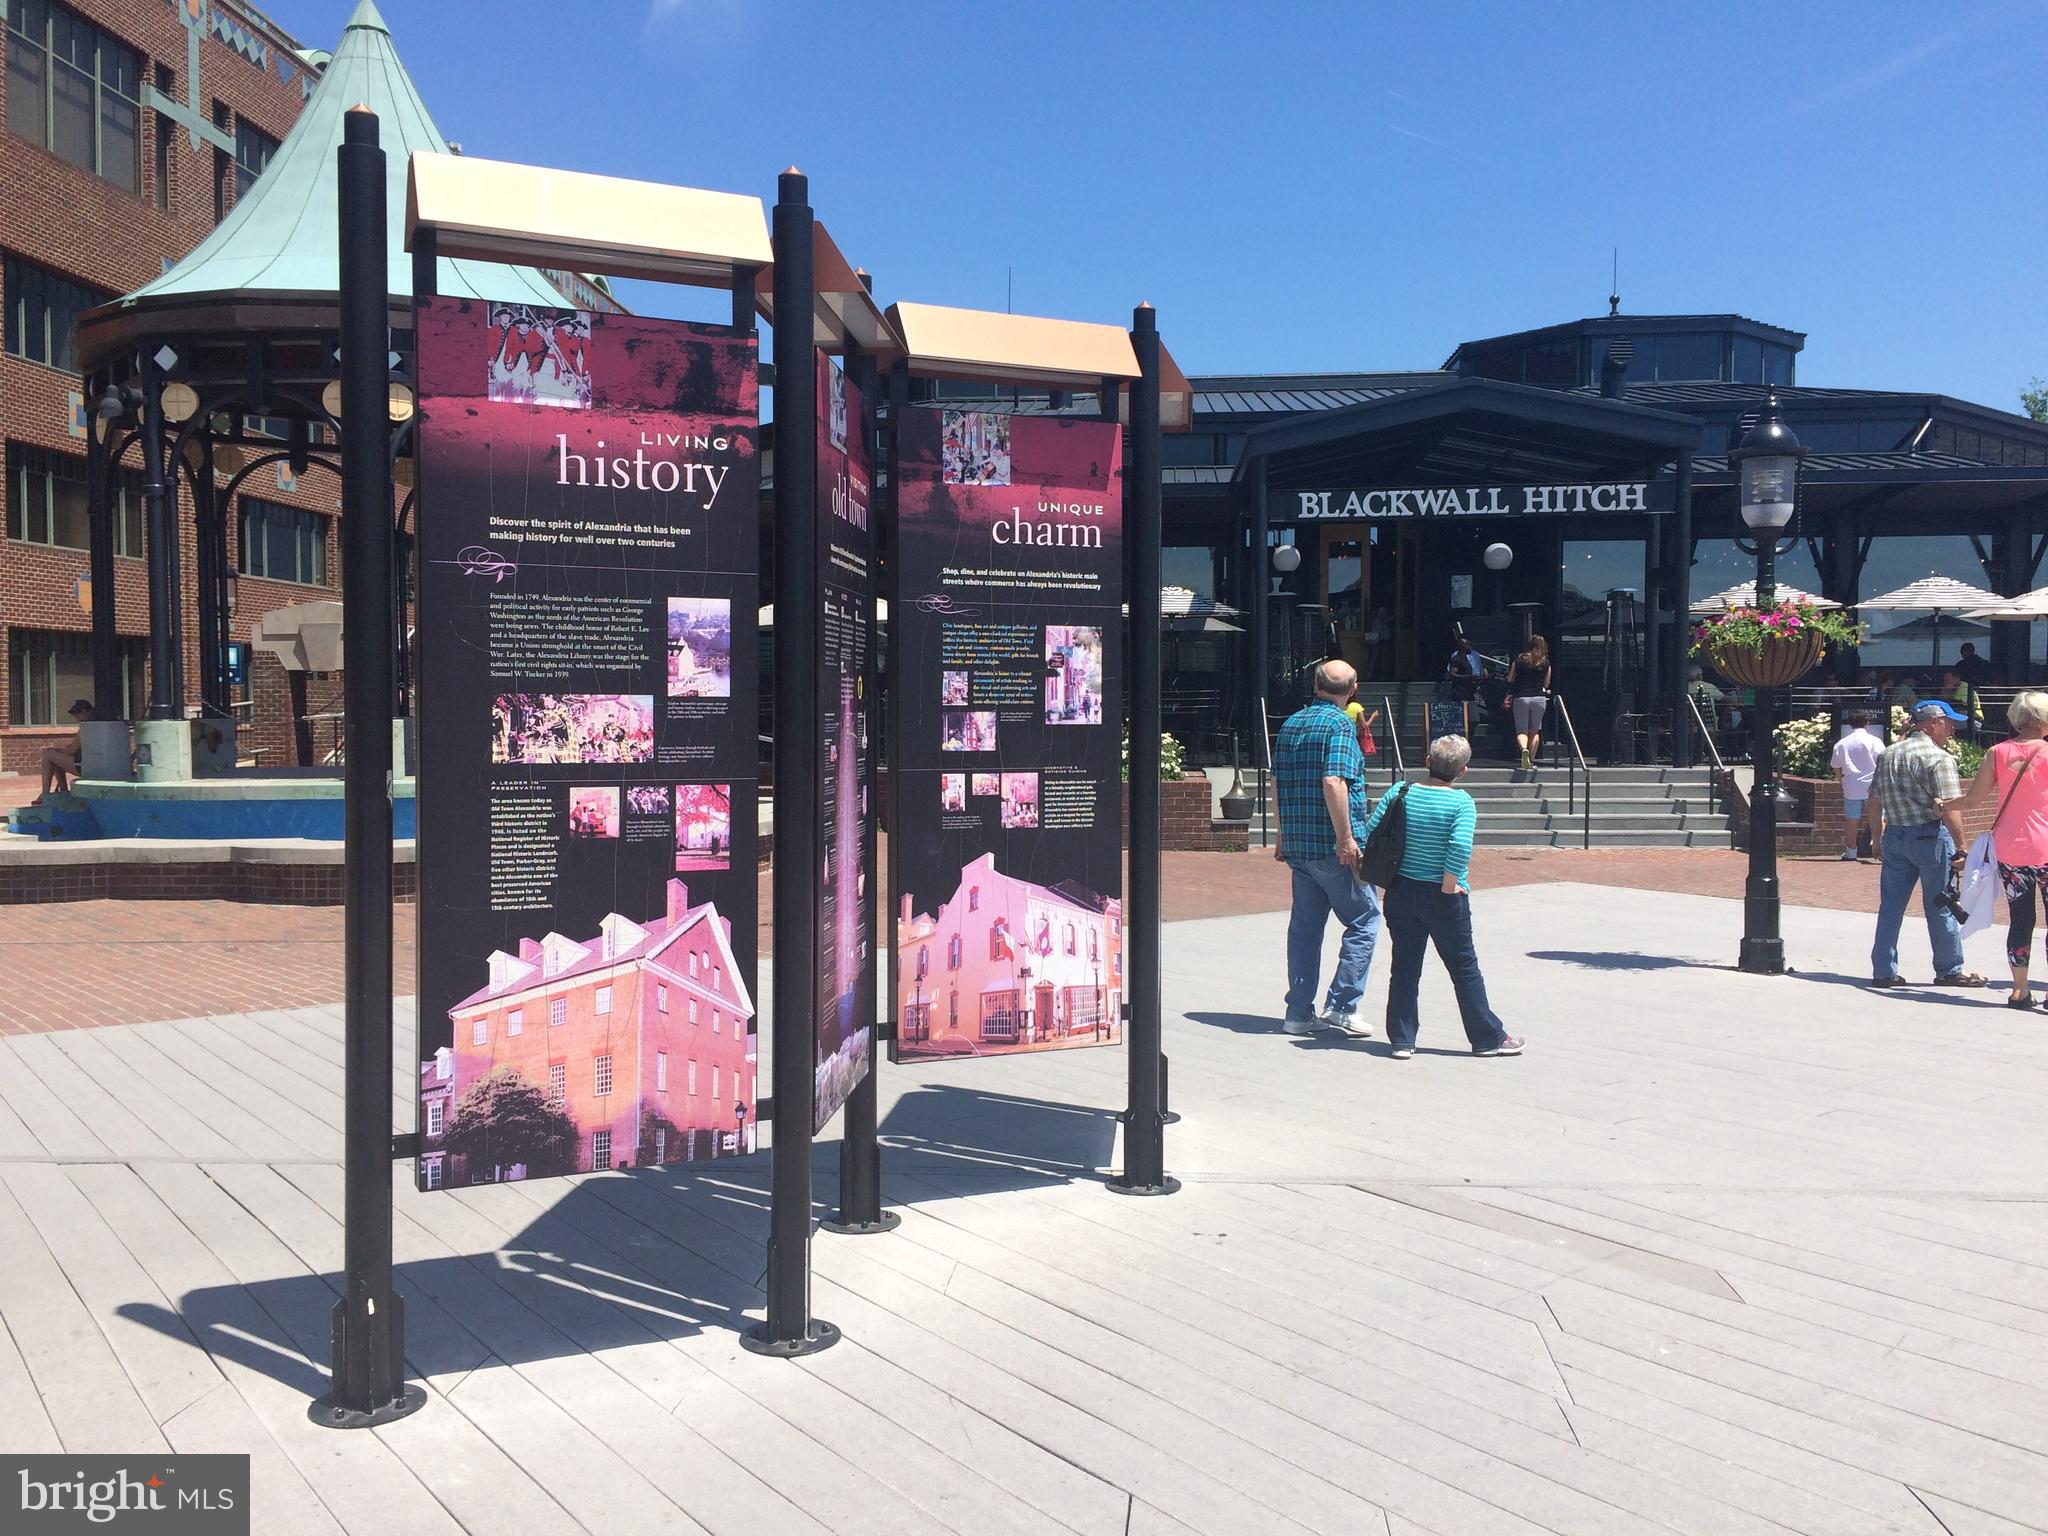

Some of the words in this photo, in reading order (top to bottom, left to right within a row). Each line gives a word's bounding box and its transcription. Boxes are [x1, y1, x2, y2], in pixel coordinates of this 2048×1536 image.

[640, 431, 728, 450] LIVING
[556, 434, 728, 510] history
[832, 473, 846, 520] old
[849, 488, 866, 532] town
[1298, 488, 1509, 518] BLACKWALL
[1523, 484, 1647, 513] HITCH
[1038, 502, 1103, 516] UNIQUE
[490, 517, 528, 526] Discover
[531, 519, 546, 528] the
[548, 520, 571, 530] spirit
[574, 521, 583, 529] of
[585, 522, 632, 532] Alexandria
[634, 524, 652, 533] that
[654, 525, 668, 534] has
[670, 526, 691, 535] been
[992, 507, 1102, 548] charm
[490, 531, 524, 542] making
[526, 532, 557, 544] history
[559, 534, 572, 542] for
[575, 535, 594, 544] well
[637, 539, 675, 547] centuries
[942, 568, 959, 576] Shop,
[1027, 581, 1047, 589] always
[1063, 582, 1101, 591] revolutionary
[490, 612, 526, 621] Washington
[562, 604, 576, 612] early
[622, 607, 644, 615] George
[506, 622, 523, 630] being
[508, 632, 548, 640] headquarters
[541, 661, 557, 670] rights
